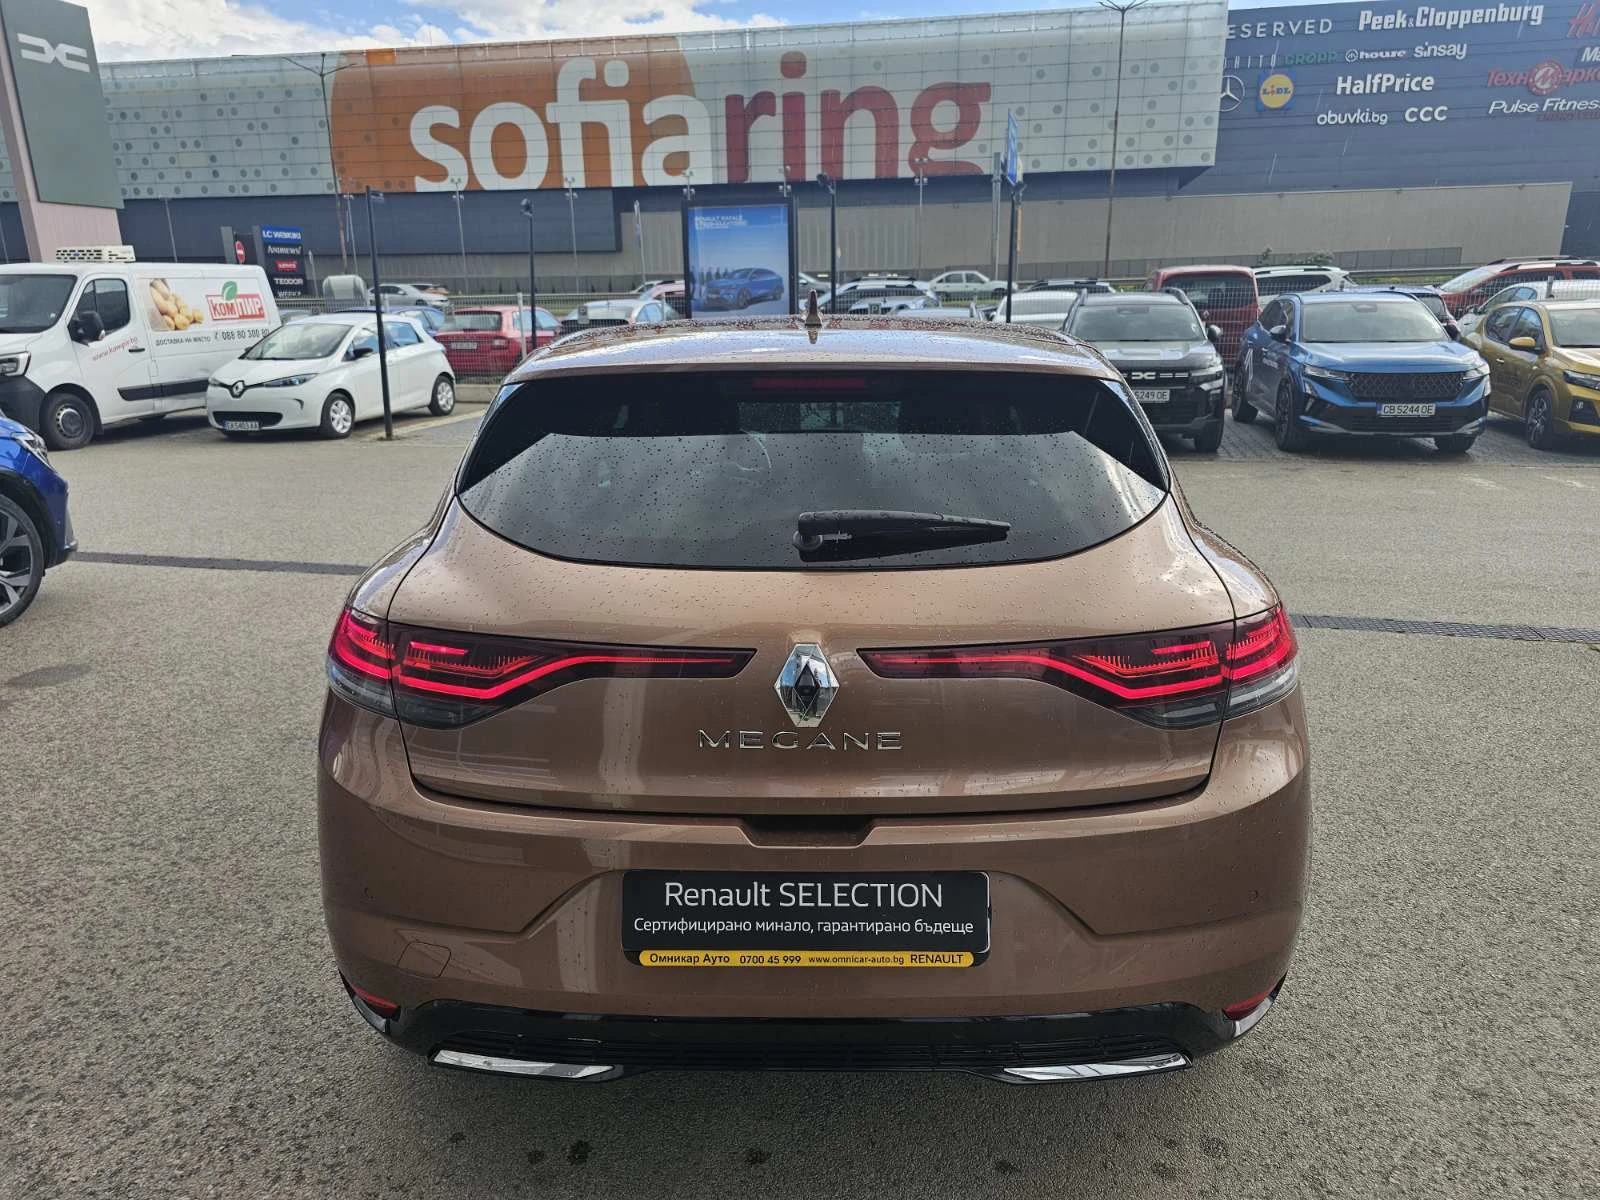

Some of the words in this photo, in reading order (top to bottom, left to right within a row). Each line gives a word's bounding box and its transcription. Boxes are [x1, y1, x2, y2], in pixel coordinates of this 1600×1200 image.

[1226, 18, 1332, 40] ESERVED
[1414, 42, 1467, 60] sinsay
[1336, 73, 1435, 95] HalfPrice
[1404, 106, 1448, 123] CCC
[1488, 100, 1540, 114] Pulse
[1316, 109, 1388, 126] obuvki.bg
[698, 730, 903, 751] MEGANE
[664, 881, 771, 907] Renault
[779, 882, 943, 908] SELECTION
[633, 917, 752, 935] Сертифицирано
[755, 920, 814, 934] минало,
[817, 920, 911, 935] гарантирано
[914, 918, 974, 935] бъдеще
[650, 953, 700, 965] Омникар
[702, 953, 730, 965] Ауто
[739, 955, 765, 964] 0700
[767, 955, 780, 964] 45
[782, 955, 801, 964] 999
[808, 955, 905, 965] www.omnicar-auto.bg
[910, 954, 964, 964] RENAULT
